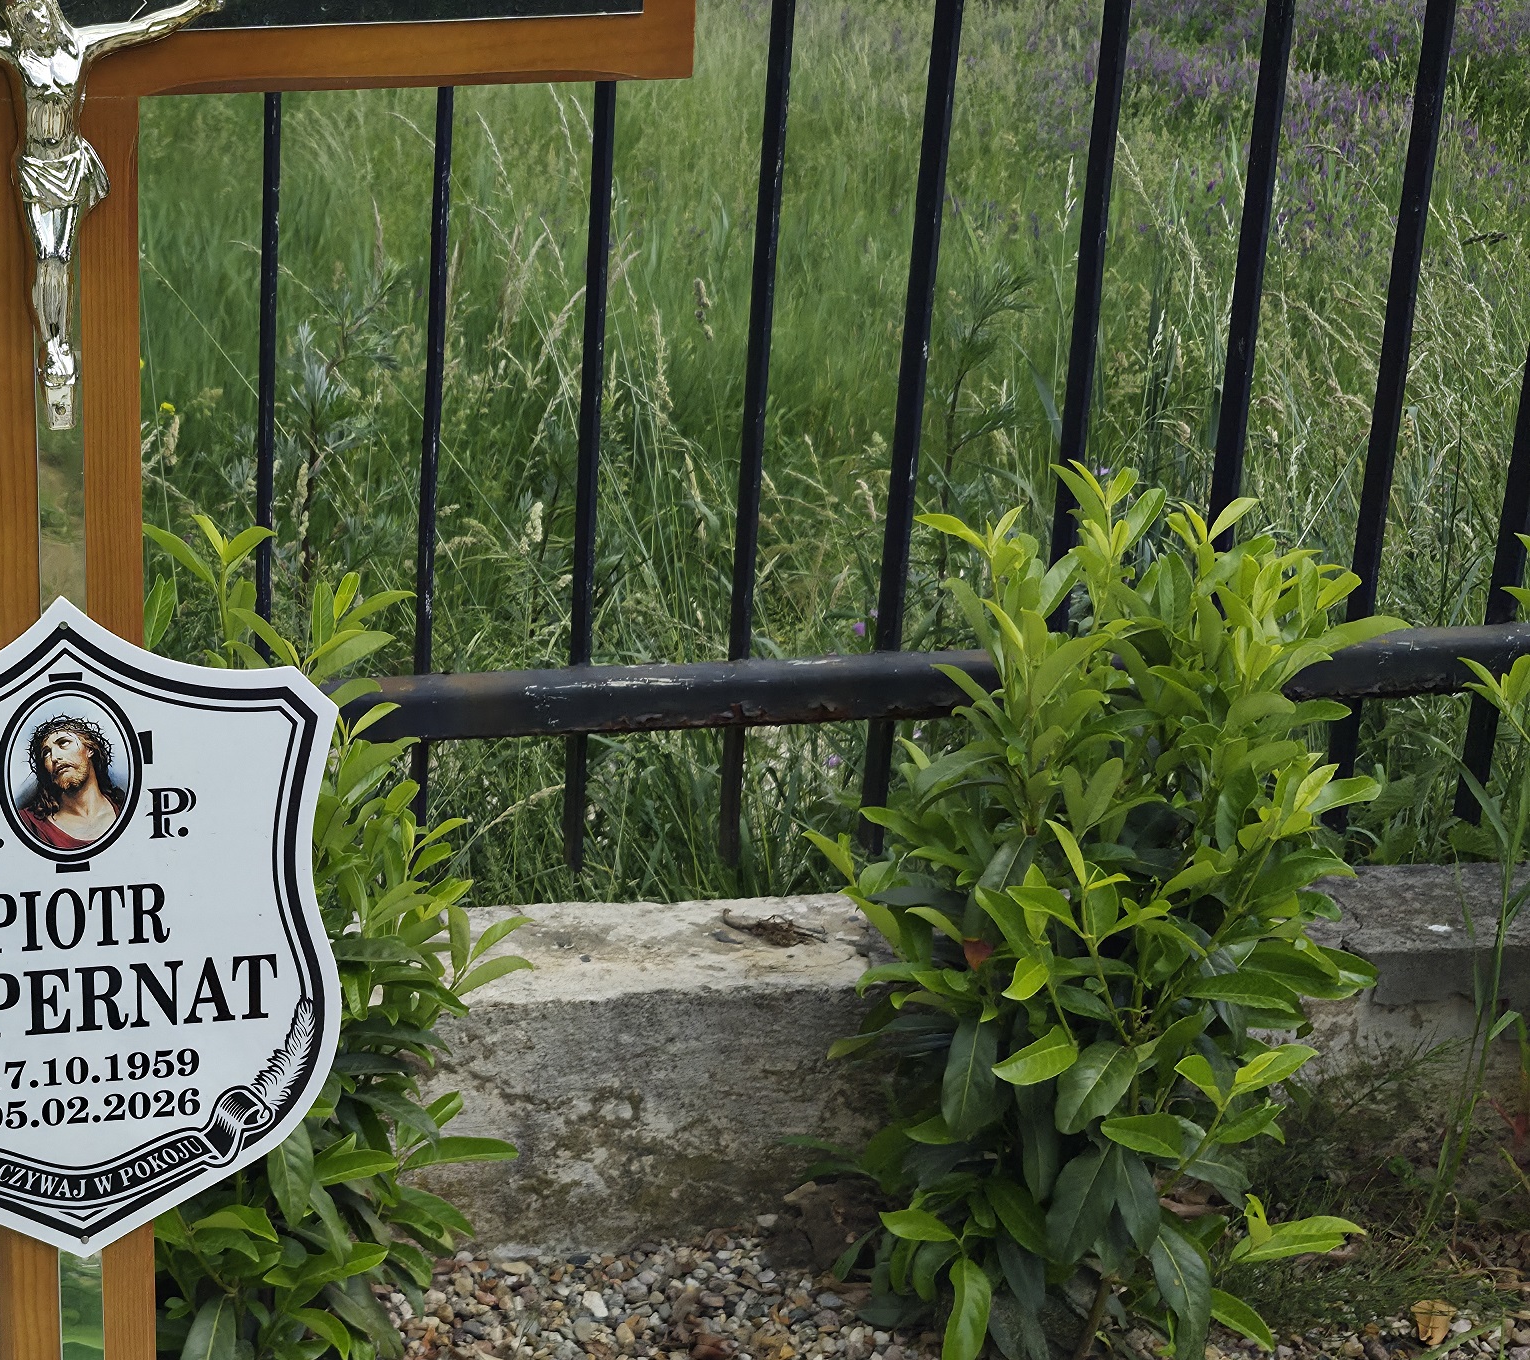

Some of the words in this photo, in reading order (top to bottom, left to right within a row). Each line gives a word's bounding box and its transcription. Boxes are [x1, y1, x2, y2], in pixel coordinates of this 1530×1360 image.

[146, 786, 197, 839] P.
[93, 1173, 114, 1195] W
[118, 1138, 203, 1187] POKOJU
